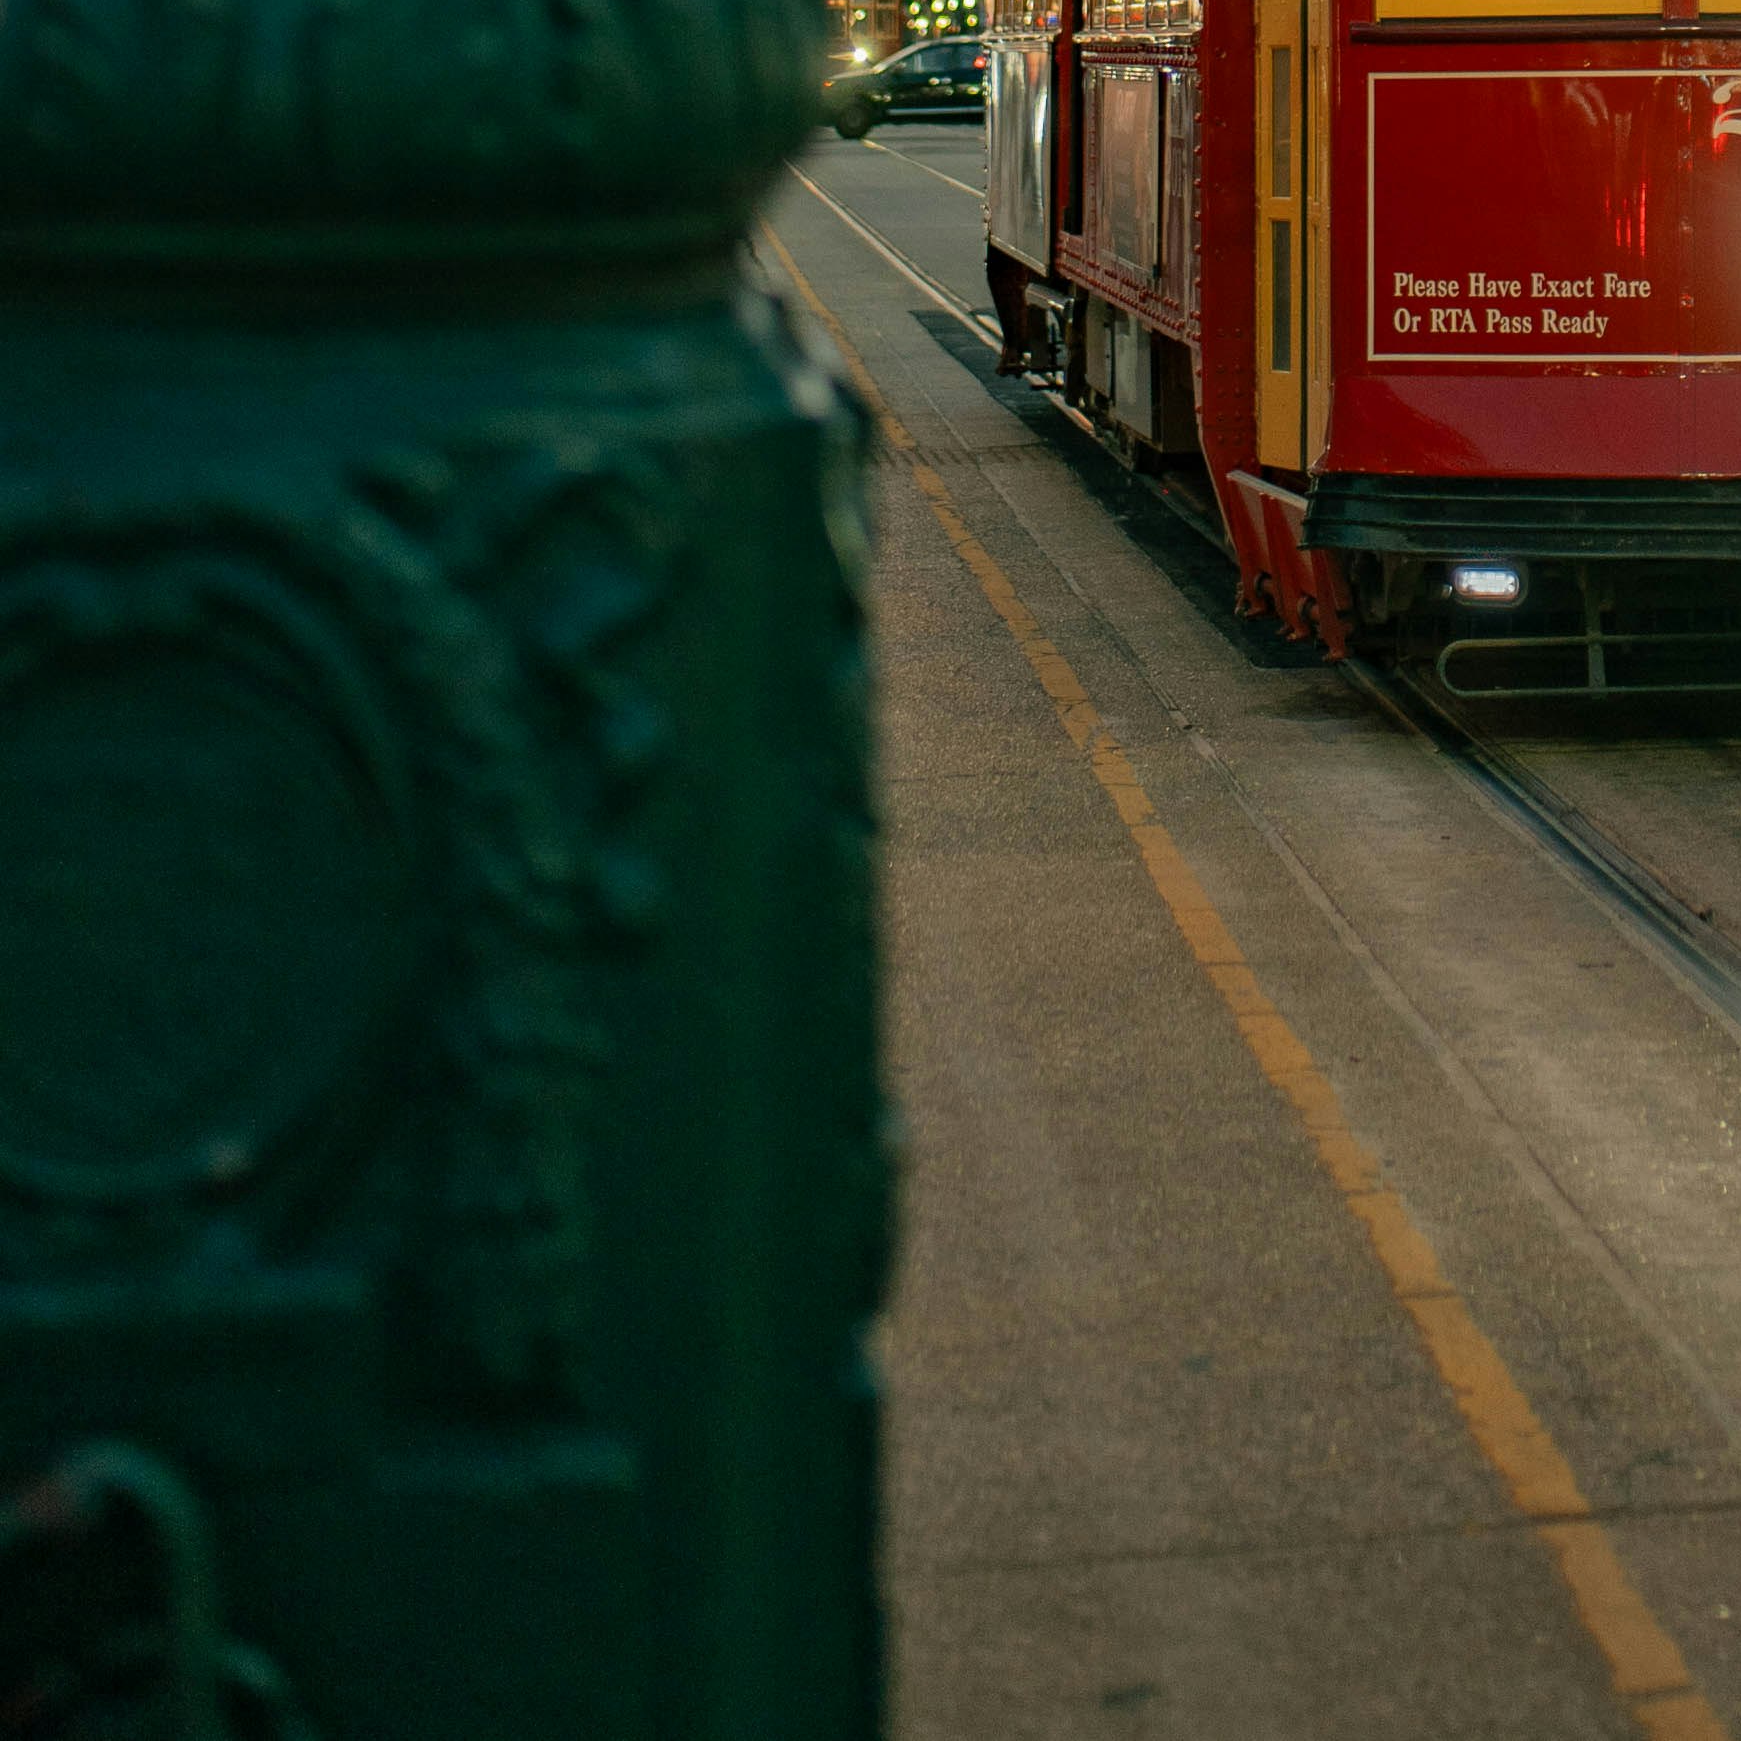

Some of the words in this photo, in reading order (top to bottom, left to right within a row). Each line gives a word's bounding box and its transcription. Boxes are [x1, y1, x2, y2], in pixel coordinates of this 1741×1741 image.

[1393, 272, 1460, 298] Please
[1468, 272, 1522, 298] Have
[1530, 272, 1595, 298] Exact
[1603, 272, 1651, 298] Fare
[1393, 307, 1422, 334] Or
[1430, 308, 1477, 334] RTA
[1485, 308, 1533, 334] Pass
[1541, 308, 1609, 339] Ready
